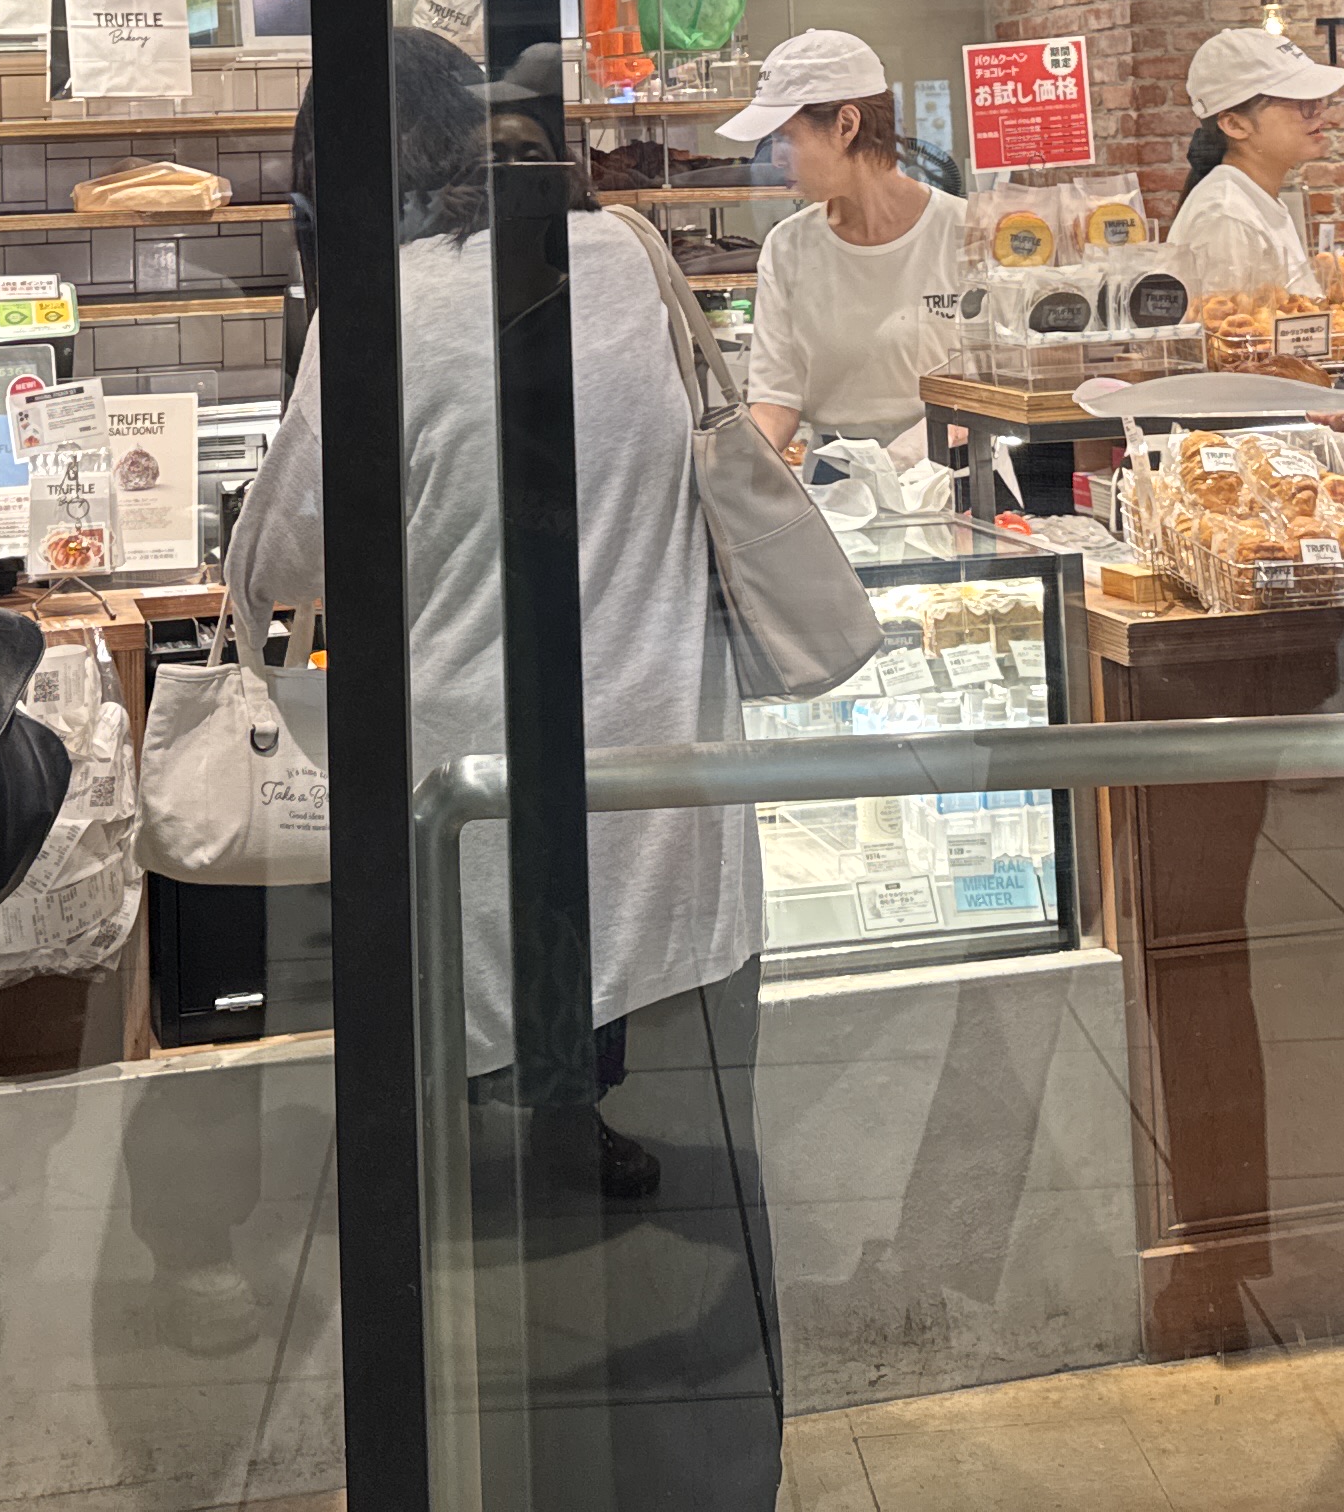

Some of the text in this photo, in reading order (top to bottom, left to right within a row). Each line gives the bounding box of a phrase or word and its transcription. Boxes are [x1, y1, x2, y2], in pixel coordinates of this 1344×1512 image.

[93, 12, 164, 28] TRUFFLE
[108, 29, 151, 49] Bakery
[974, 52, 1028, 67] バウムクーヘン
[975, 65, 1020, 79] チョコレート
[974, 76, 1079, 107] お試し価格
[1103, 218, 1136, 229] TRUFFLE
[1009, 233, 1042, 248] TRUFFLE
[15, 380, 37, 391] NEW!
[108, 412, 166, 426] TRUFFLE
[108, 426, 165, 436] SALT DONUT
[1305, 544, 1338, 554] TRUFFLE
[261, 780, 296, 806] Take
[298, 793, 308, 803] a
[962, 876, 1025, 892] MINERAL
[964, 892, 1014, 908] WATER
